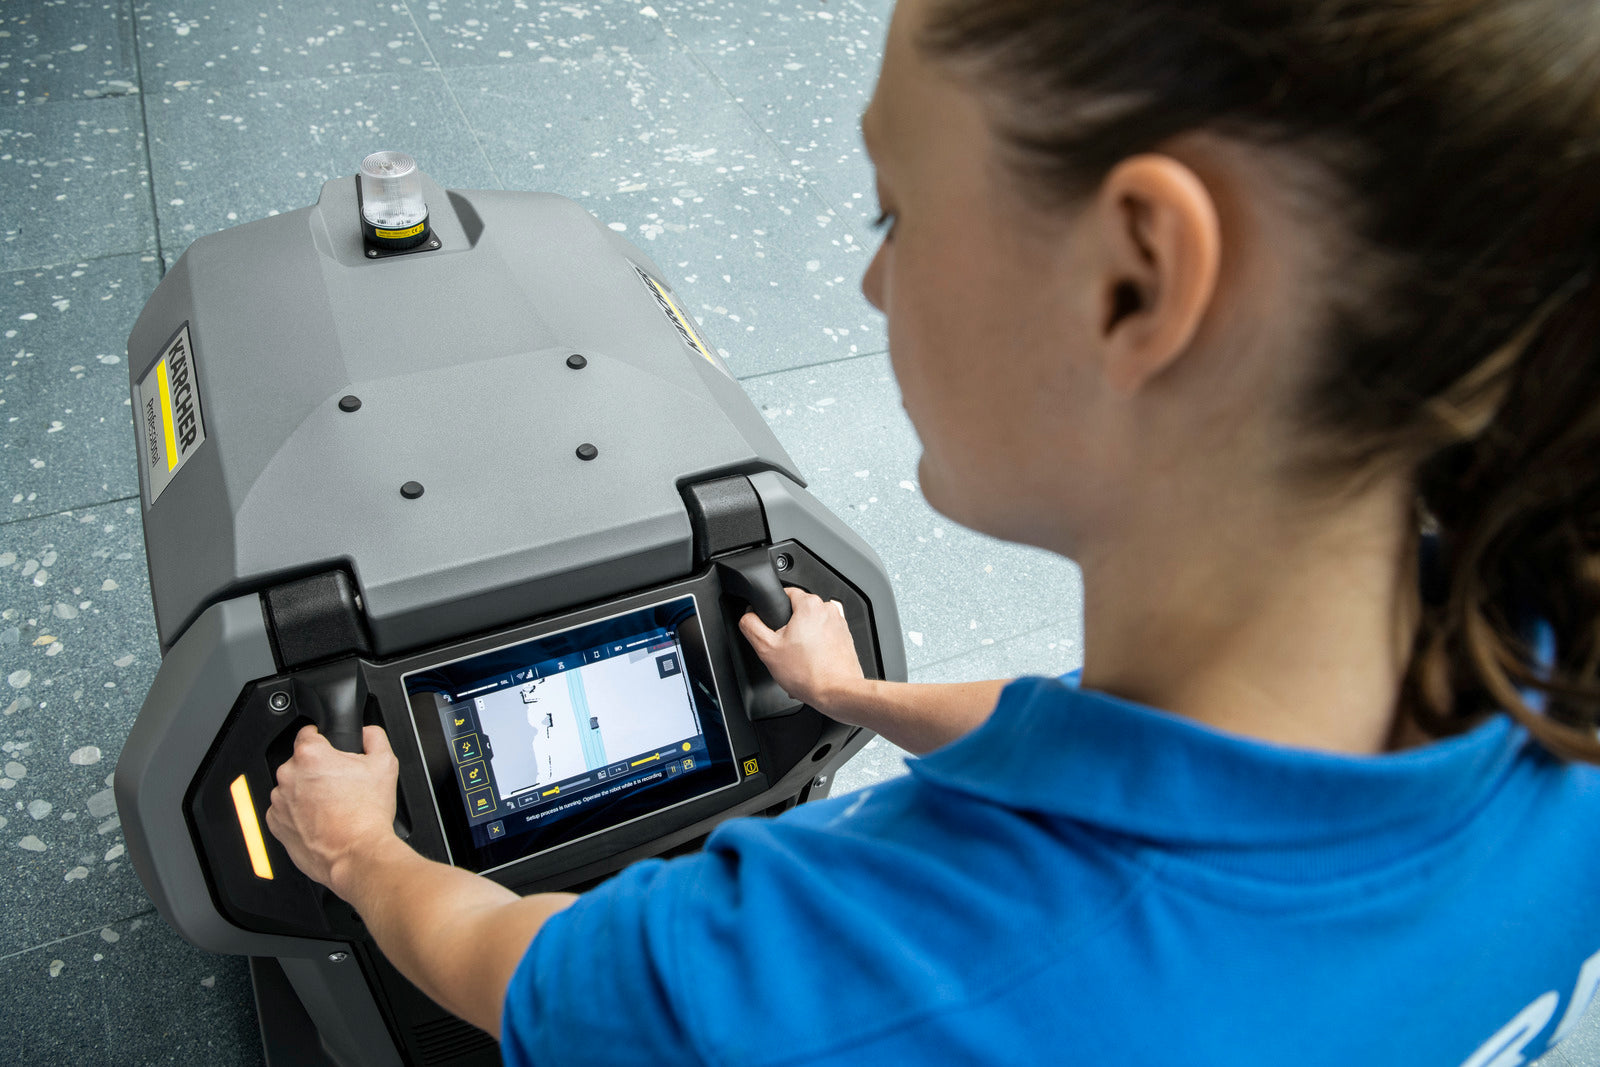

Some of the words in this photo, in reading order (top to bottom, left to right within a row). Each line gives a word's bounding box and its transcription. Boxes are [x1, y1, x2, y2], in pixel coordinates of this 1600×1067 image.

[168, 336, 197, 456] KÄRCHER
[146, 397, 160, 468] Professional
[525, 813, 540, 822] Setup
[541, 807, 559, 818] process
[582, 793, 601, 803] Operate
[609, 785, 621, 794] robot
[621, 781, 633, 790] while
[641, 771, 663, 782] recording
